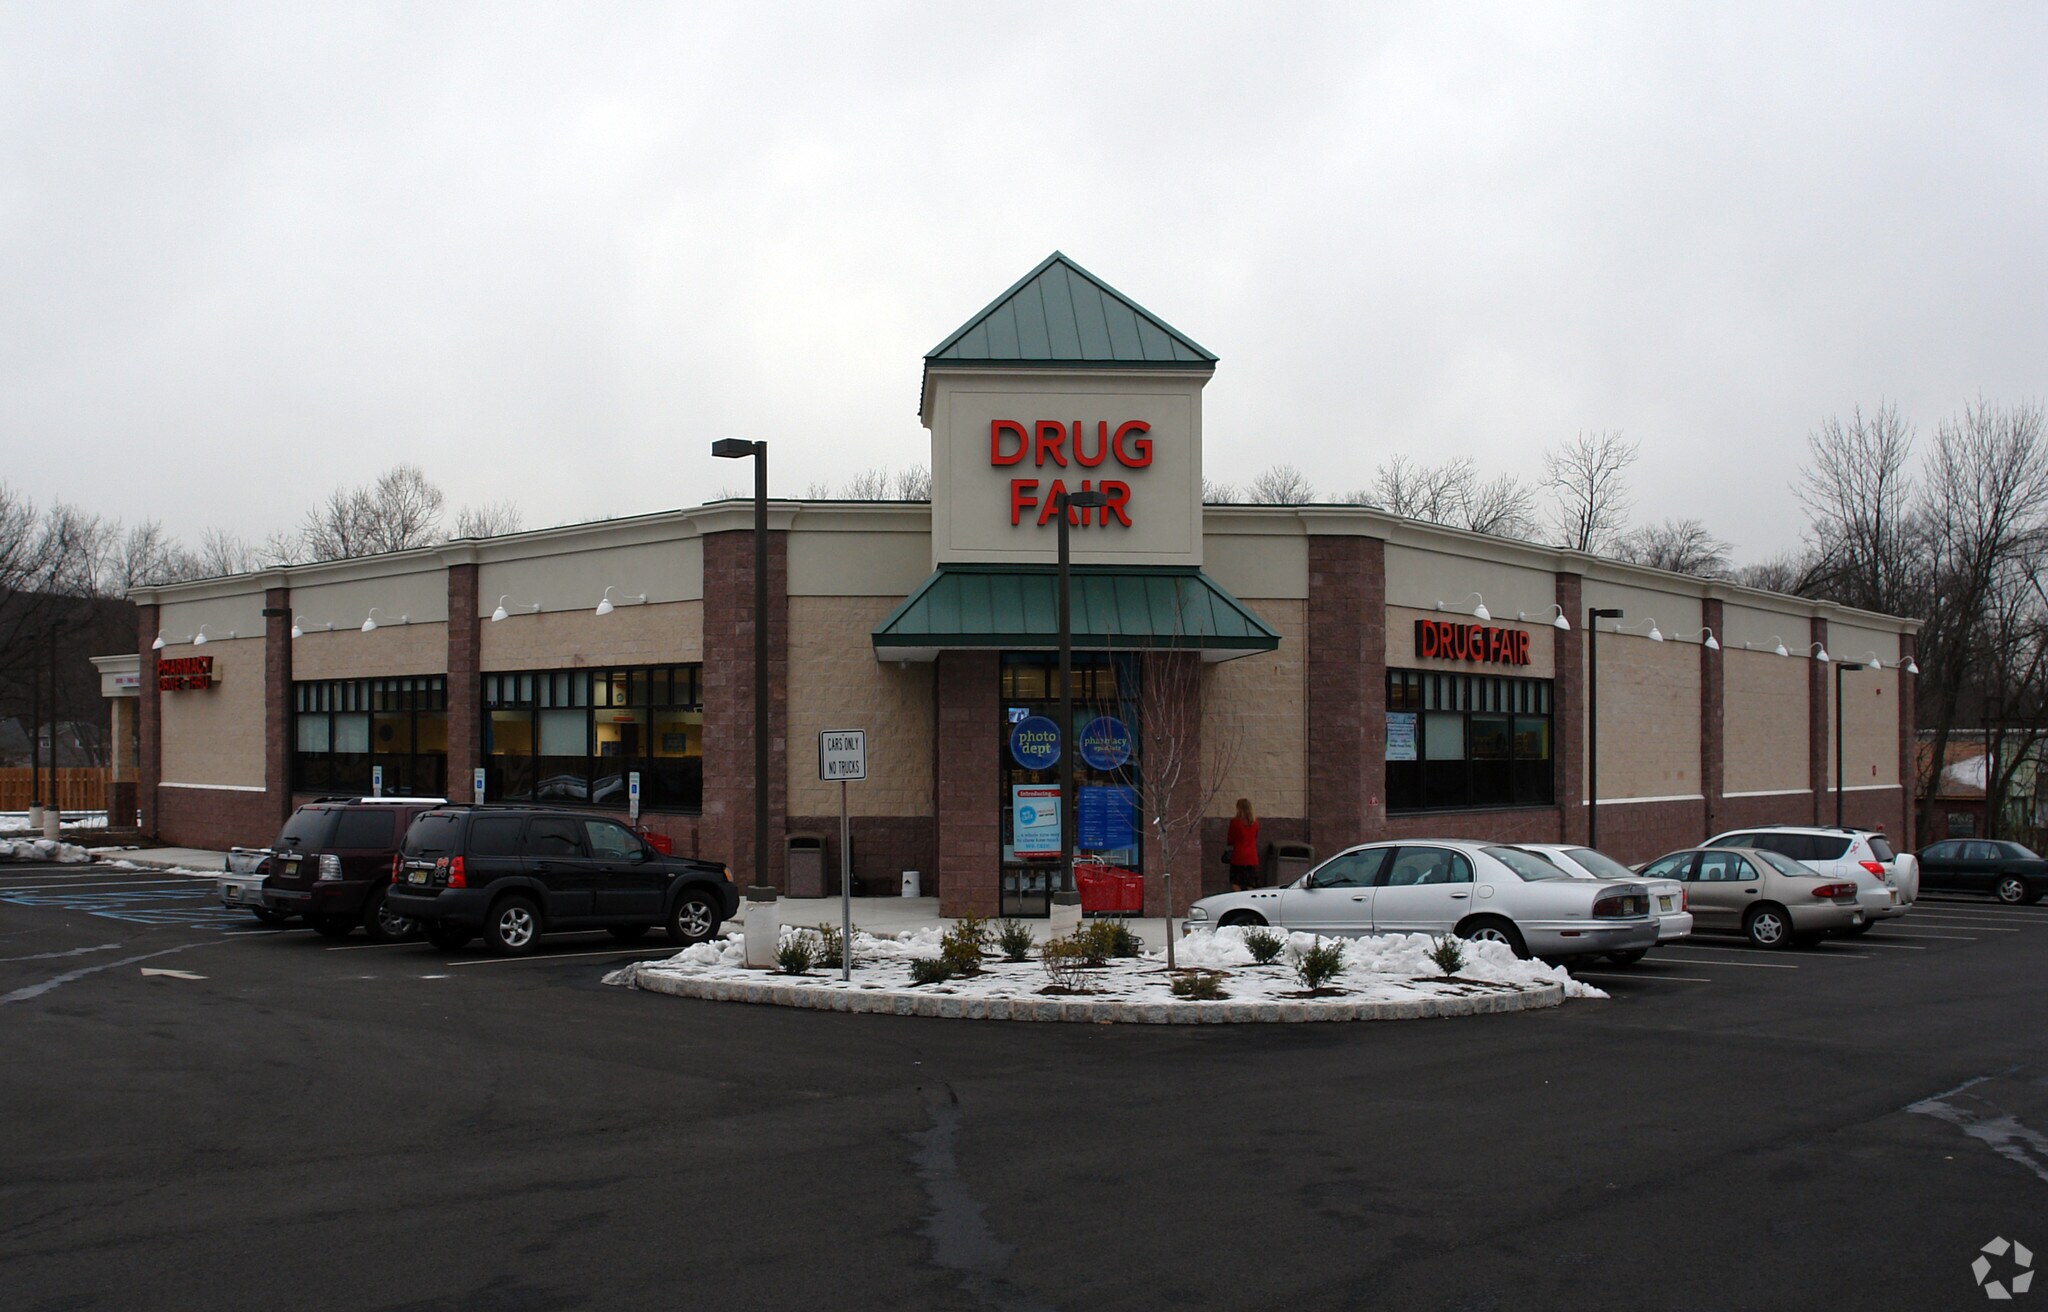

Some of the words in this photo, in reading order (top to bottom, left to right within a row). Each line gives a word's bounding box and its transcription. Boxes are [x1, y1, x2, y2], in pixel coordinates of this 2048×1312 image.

[991, 419, 1153, 468] DRUG
[1011, 479, 1132, 527] FAIR
[1420, 619, 1485, 661] DRUG
[1489, 627, 1531, 665] FAIR
[157, 656, 211, 676] PHARMACY
[828, 737, 843, 751] CARS
[844, 737, 859, 751] ONLY
[1019, 730, 1056, 746] photo
[1084, 736, 1127, 747] pharmacy
[1022, 742, 1051, 757] dept
[829, 761, 837, 775] NO
[838, 760, 860, 774] TRUCKS
